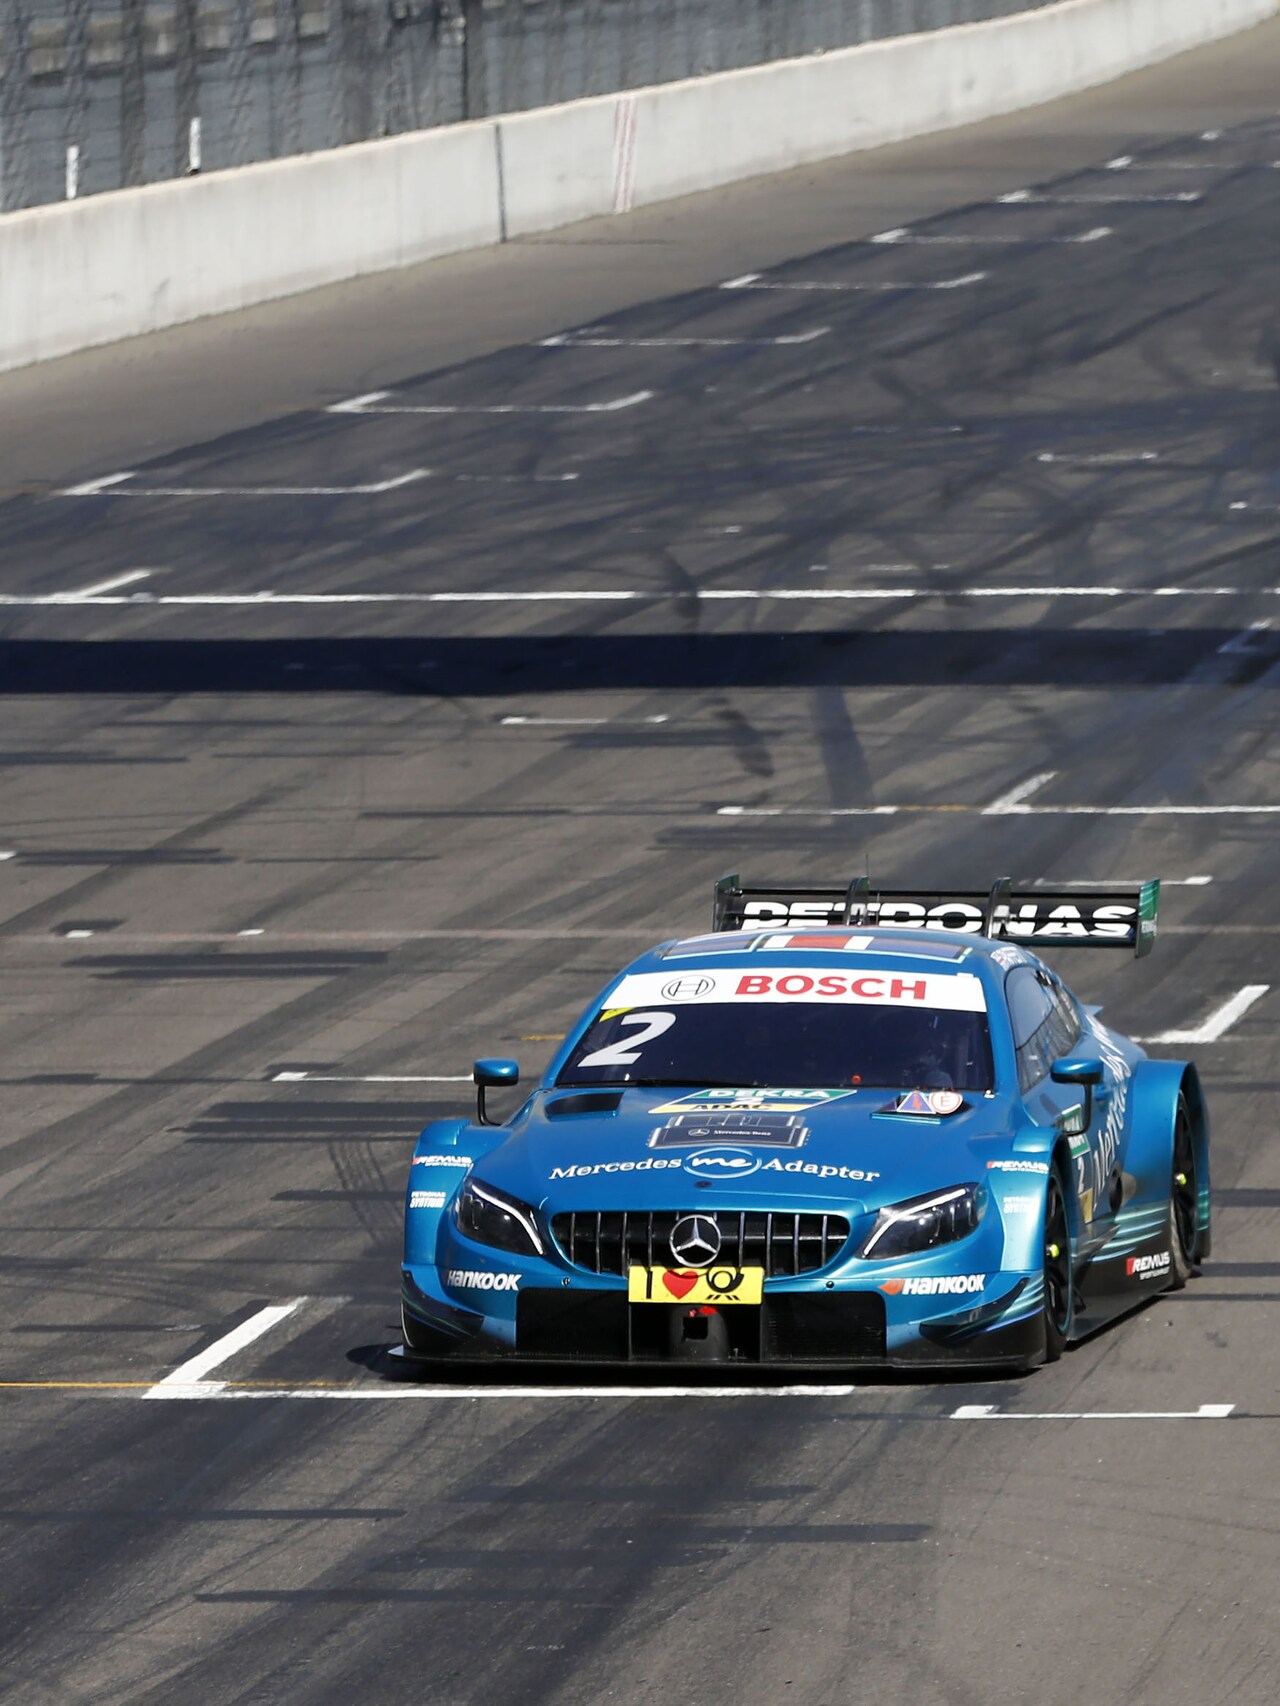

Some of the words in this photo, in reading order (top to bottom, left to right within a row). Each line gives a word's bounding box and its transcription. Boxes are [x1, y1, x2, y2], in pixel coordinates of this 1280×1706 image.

[735, 975, 926, 1000] BOSCH
[577, 1011, 676, 1067] 2
[708, 1089, 831, 1098] DEKRA
[548, 1158, 682, 1180] Mercedes
[691, 1157, 753, 1168] me
[761, 1158, 881, 1182] Adapter
[1132, 1251, 1171, 1274] REMUS
